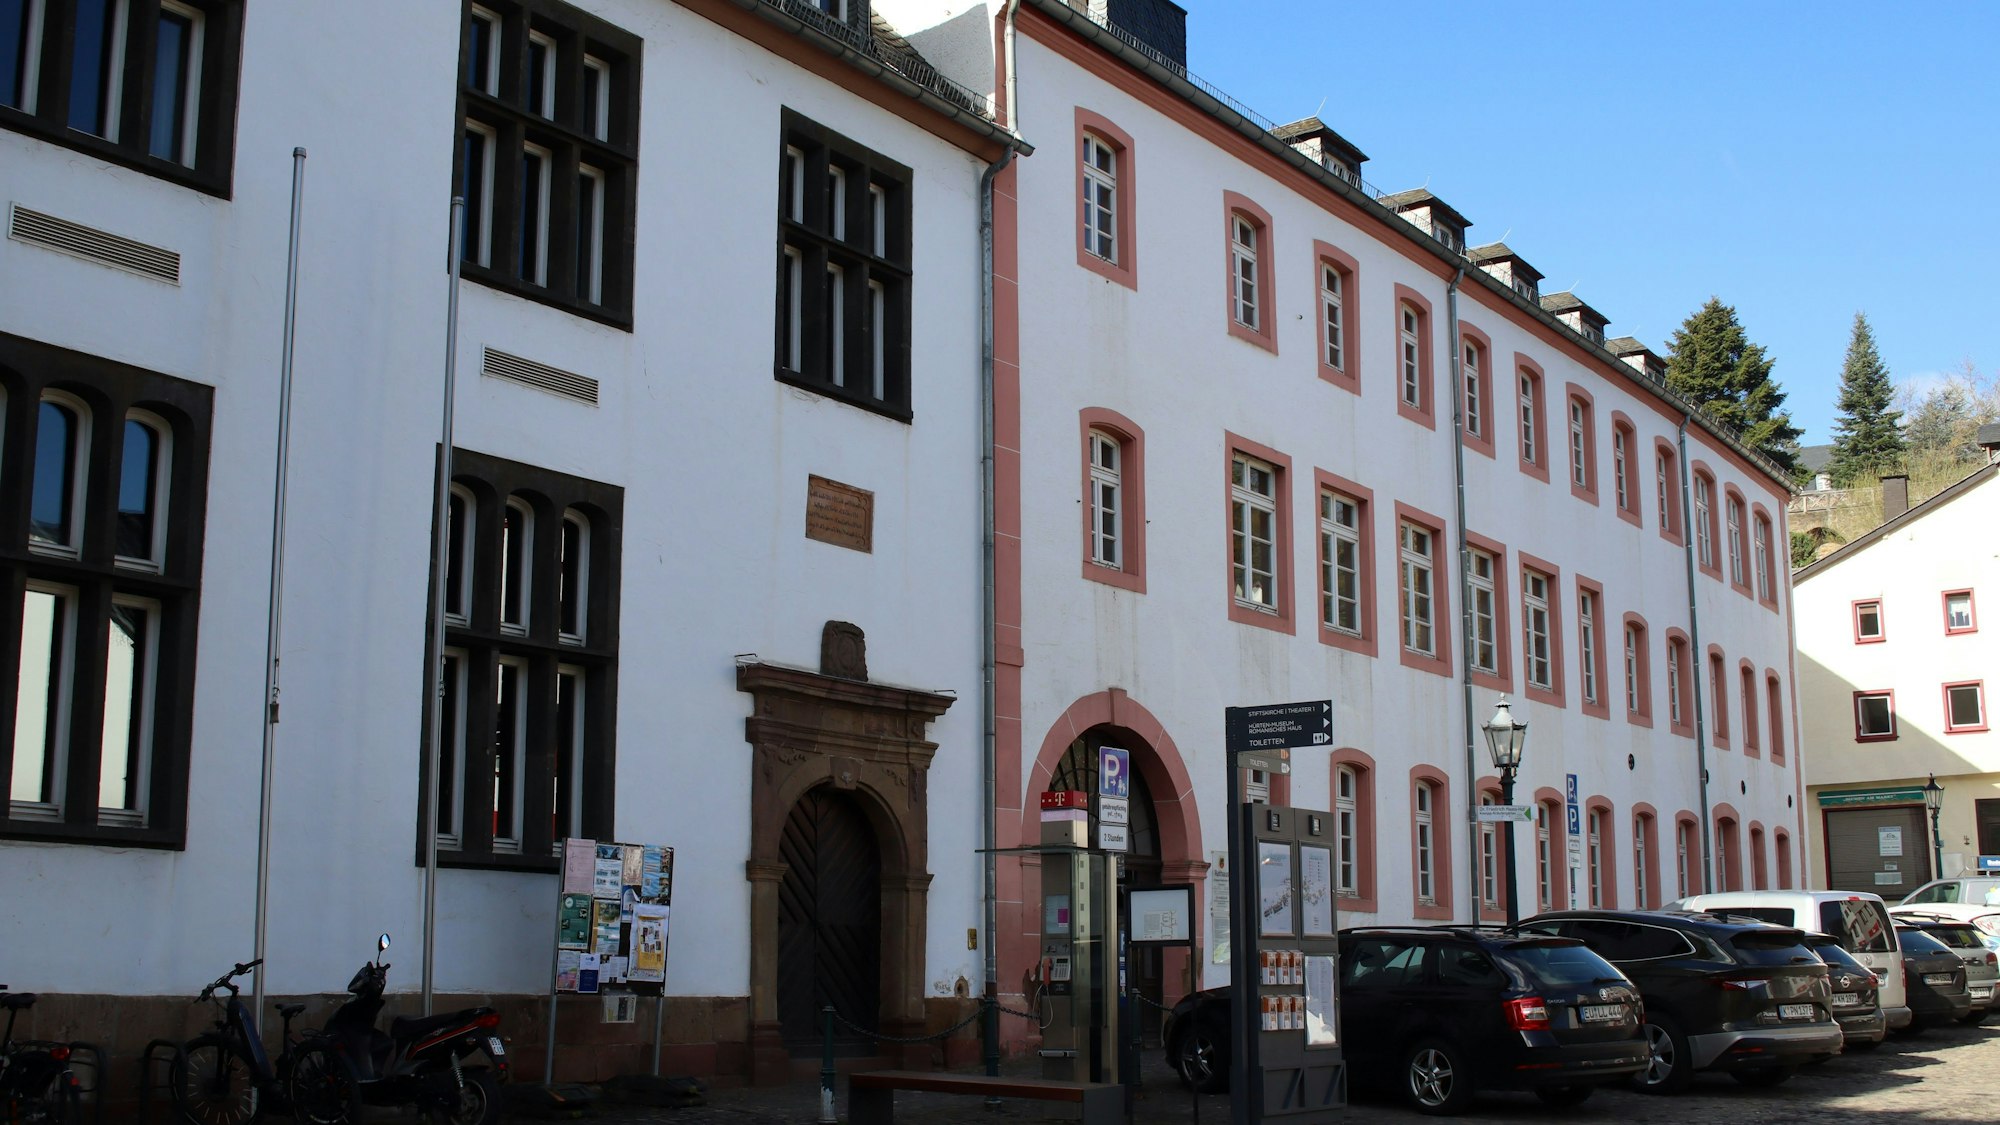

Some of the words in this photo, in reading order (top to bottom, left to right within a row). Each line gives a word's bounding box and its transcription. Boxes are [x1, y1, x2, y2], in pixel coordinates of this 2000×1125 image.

[1248, 709, 1284, 717] STIFTSKIRCHE
[1249, 738, 1285, 747] TOILETTEN
[1249, 759, 1269, 768] TOILETTEN
[1105, 754, 1120, 789] P
[1568, 777, 1575, 800] P
[1054, 791, 1066, 807] T
[1570, 808, 1577, 831] P
[1107, 833, 1124, 843] Stunden
